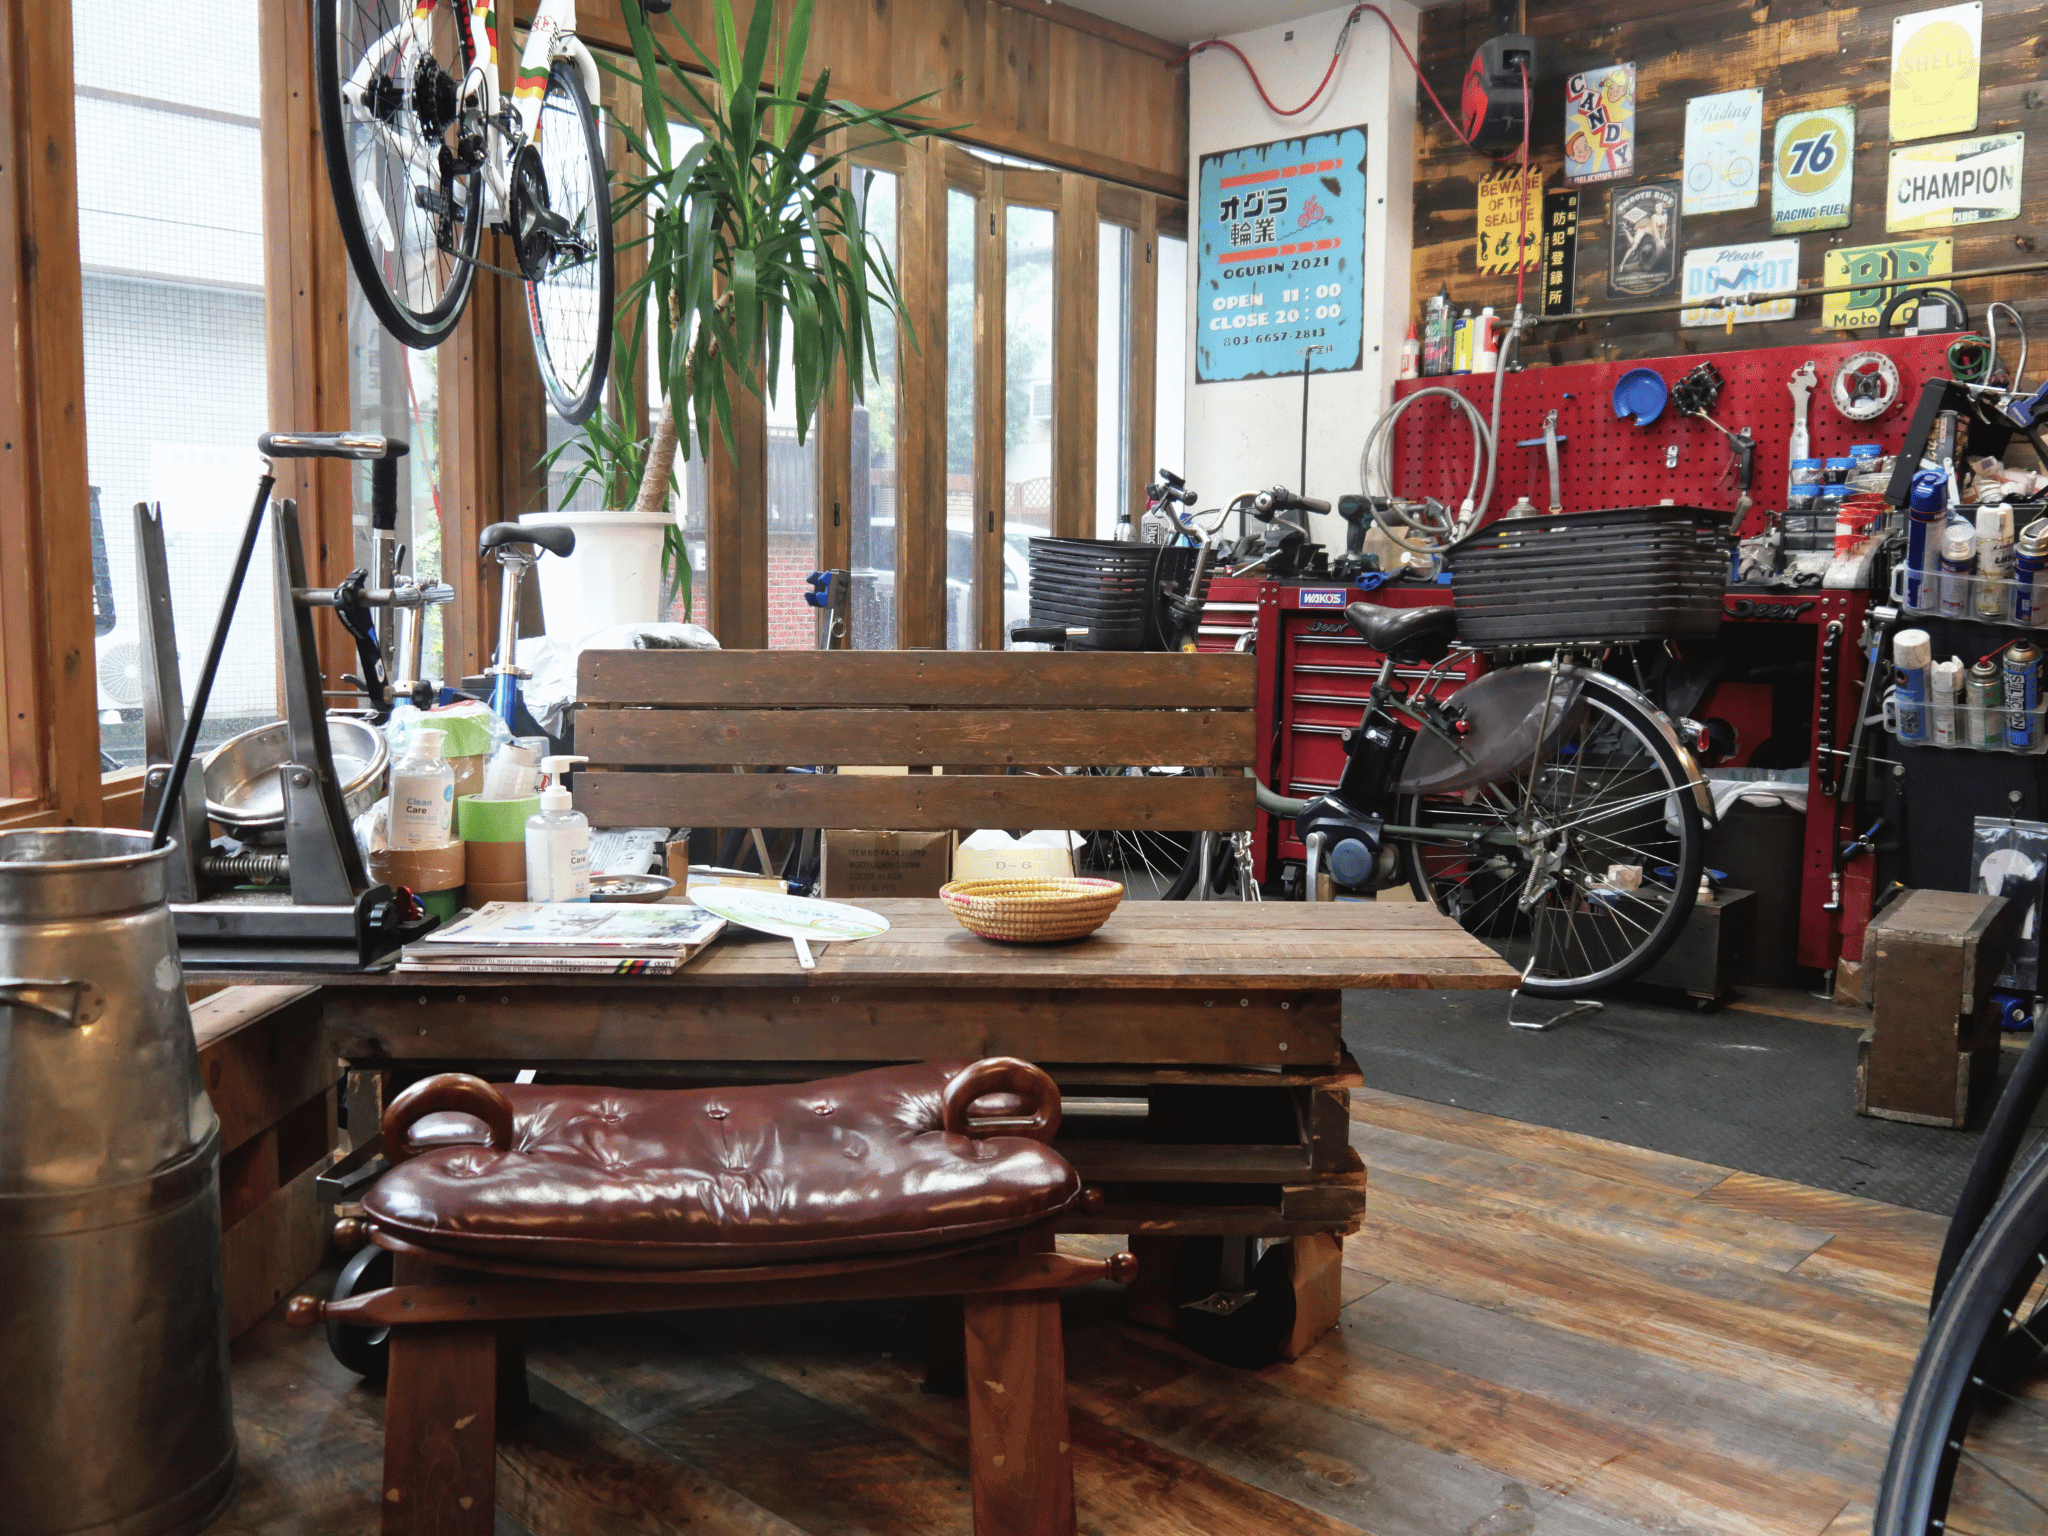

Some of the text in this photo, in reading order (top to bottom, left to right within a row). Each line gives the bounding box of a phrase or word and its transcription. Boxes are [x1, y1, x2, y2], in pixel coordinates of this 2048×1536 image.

[1904, 50, 1966, 76] SHELL
[1570, 75, 1629, 165] CANDY
[1695, 101, 1752, 123] Riding
[1789, 132, 1837, 179] 76
[1897, 165, 2014, 204] CHAMPION
[1219, 187, 1288, 222] オグラ
[1489, 197, 1505, 212] OF
[1618, 190, 1652, 212] SMOOTH
[1485, 208, 1535, 227] SEALIE
[1775, 203, 1846, 223] RACING FUEL
[1953, 210, 1980, 223] PLUGS
[1230, 216, 1276, 247] 輪業
[1548, 211, 1566, 305] 防犯登録所
[1716, 249, 1764, 262] Please
[1223, 256, 1330, 280] OGURIN 2021
[1688, 266, 1721, 296] DO
[1741, 258, 1794, 291] NOT
[1845, 248, 1930, 310] BP
[1212, 292, 1264, 311] OPEN
[1210, 311, 1269, 331] CLOSE
[1834, 311, 1878, 328] Moto
[406, 805, 427, 814] Care
[407, 797, 433, 806] Clean
